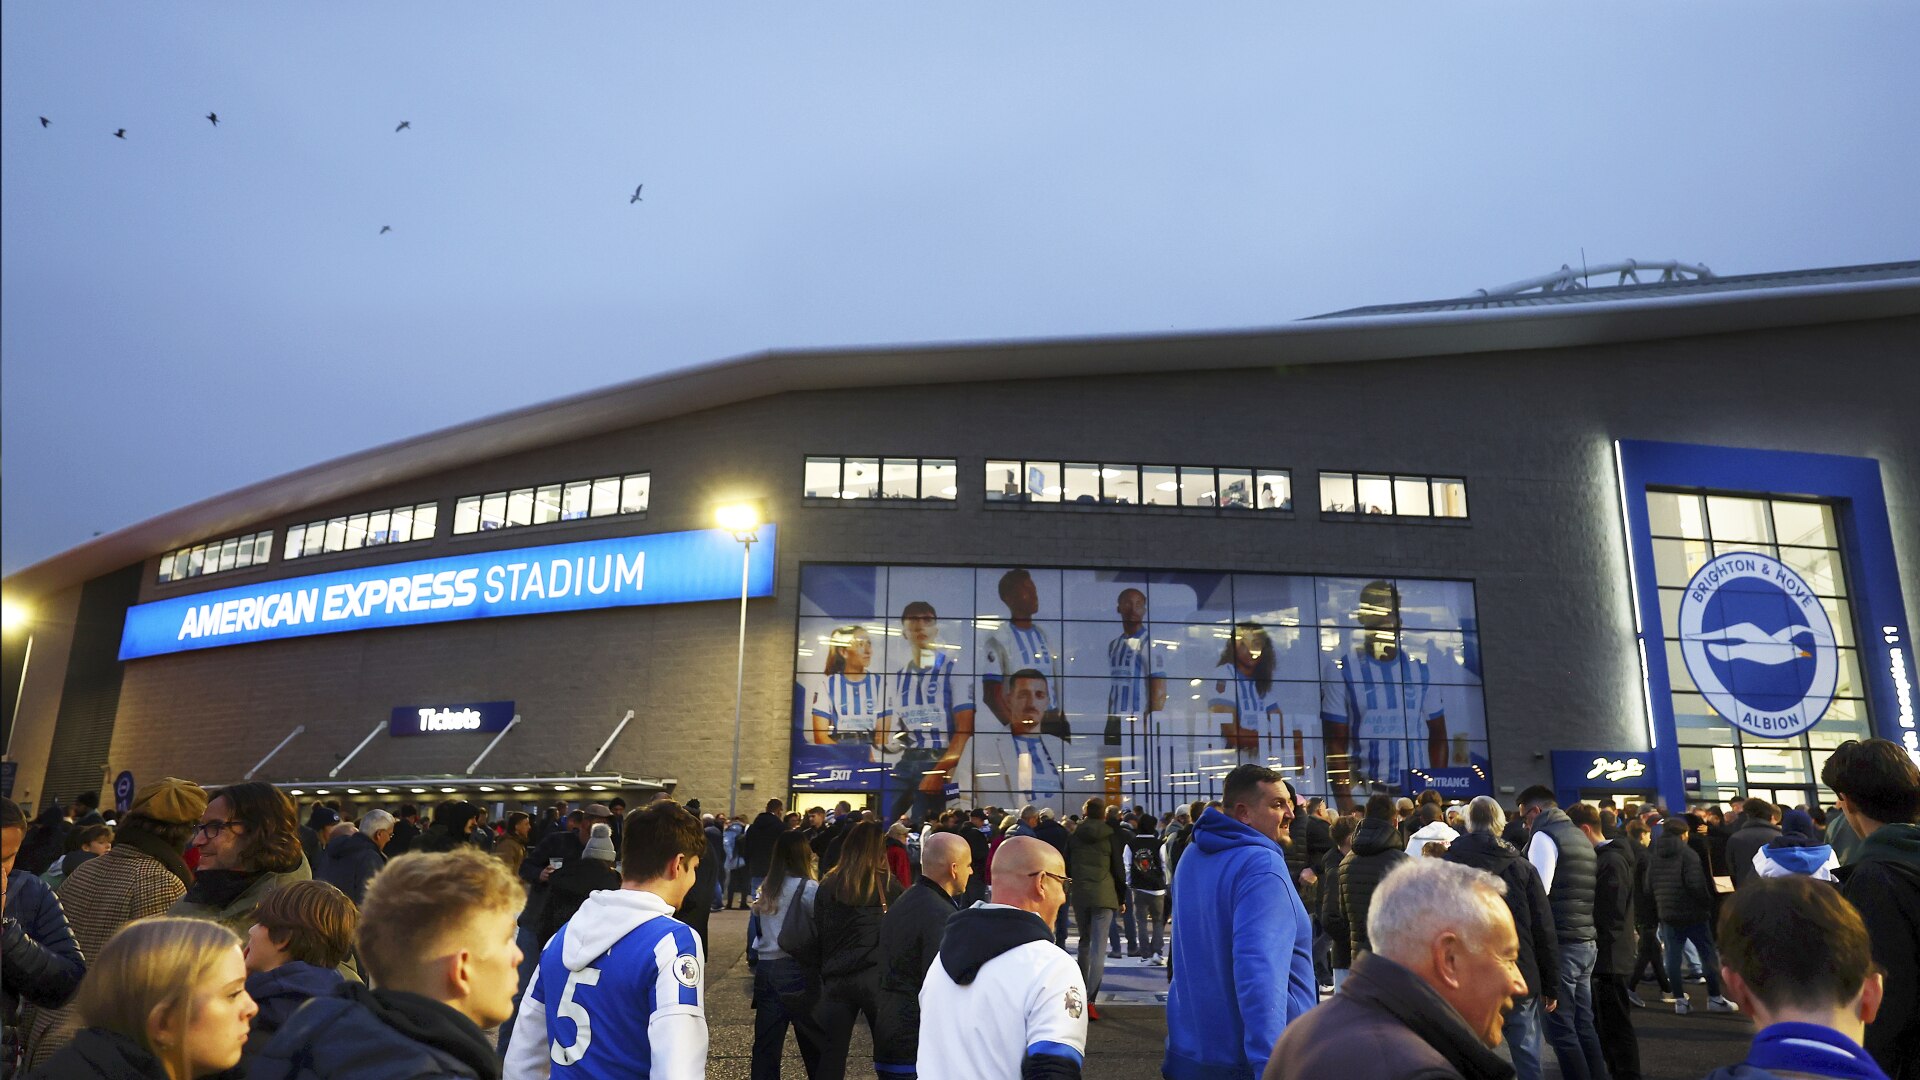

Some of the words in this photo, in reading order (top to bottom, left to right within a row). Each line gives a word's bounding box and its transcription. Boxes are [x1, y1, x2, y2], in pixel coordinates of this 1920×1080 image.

[1692, 559, 1755, 603] BRIGHTON
[1761, 563, 1771, 575] &
[1776, 568, 1813, 609] HOVE
[178, 588, 319, 641] AMERICAN
[321, 568, 480, 621] EXPRESS
[483, 551, 645, 603] STADIUM
[1882, 626, 1899, 644] 11
[418, 707, 481, 732] Tickets
[1743, 712, 1800, 730] ALBION
[829, 769, 853, 781] EXIT
[1425, 776, 1470, 788] ENTRANCE
[551, 966, 601, 1066] 5
